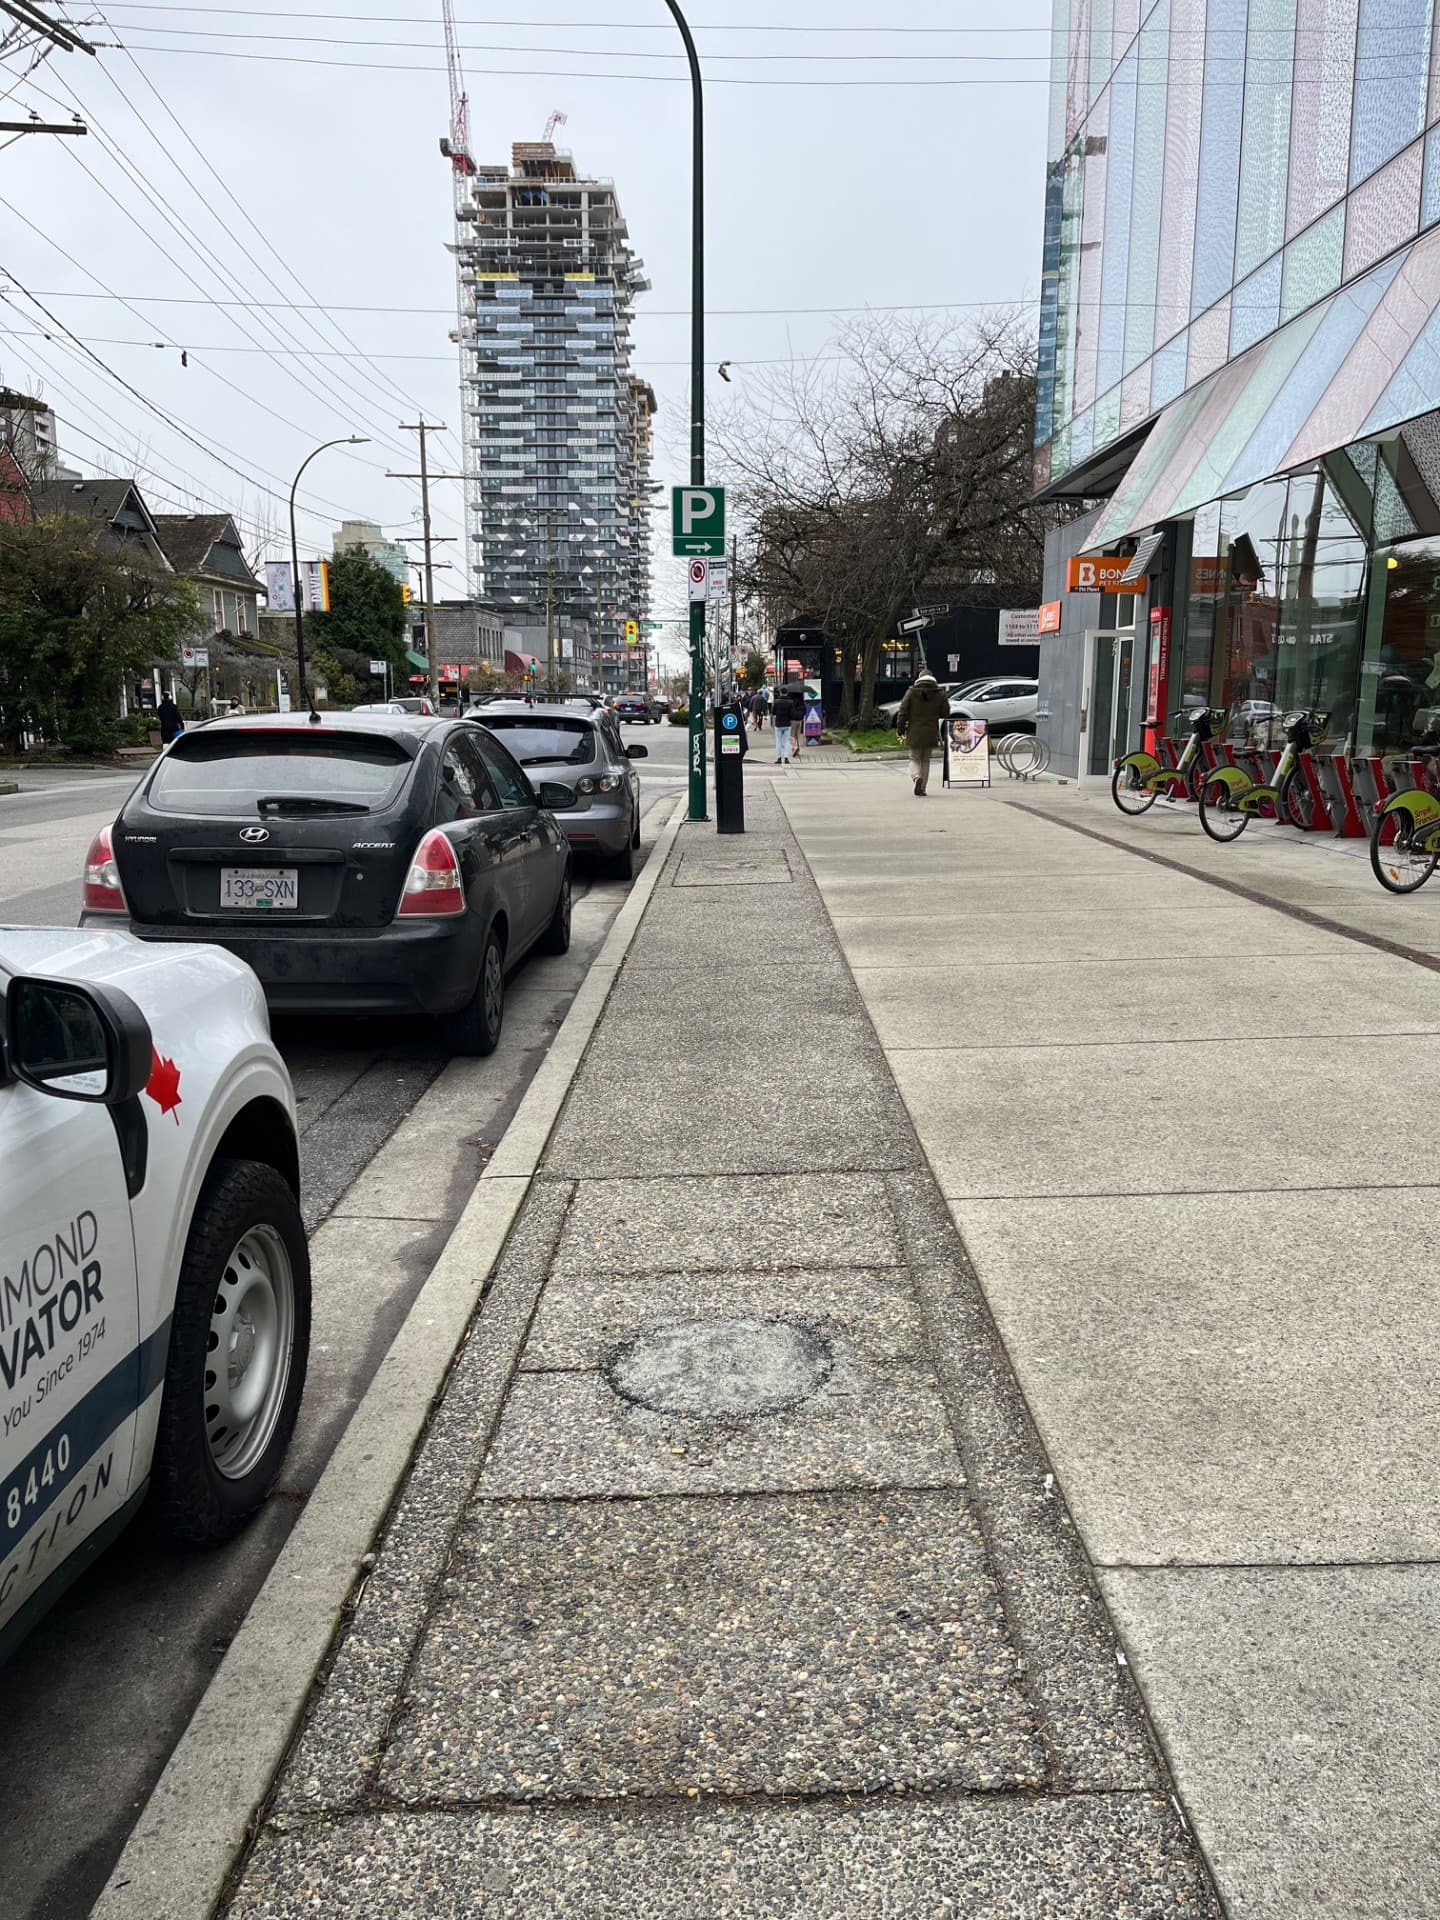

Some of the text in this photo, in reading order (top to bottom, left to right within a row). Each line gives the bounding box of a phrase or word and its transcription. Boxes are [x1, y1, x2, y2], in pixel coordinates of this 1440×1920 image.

[682, 490, 716, 534] P
[310, 571, 321, 602] DAVIE
[727, 716, 734, 727] P
[124, 835, 158, 843] HYUNDAI
[3, 1315, 106, 1437] You Since 1974
[7, 1432, 71, 1530] 8440
